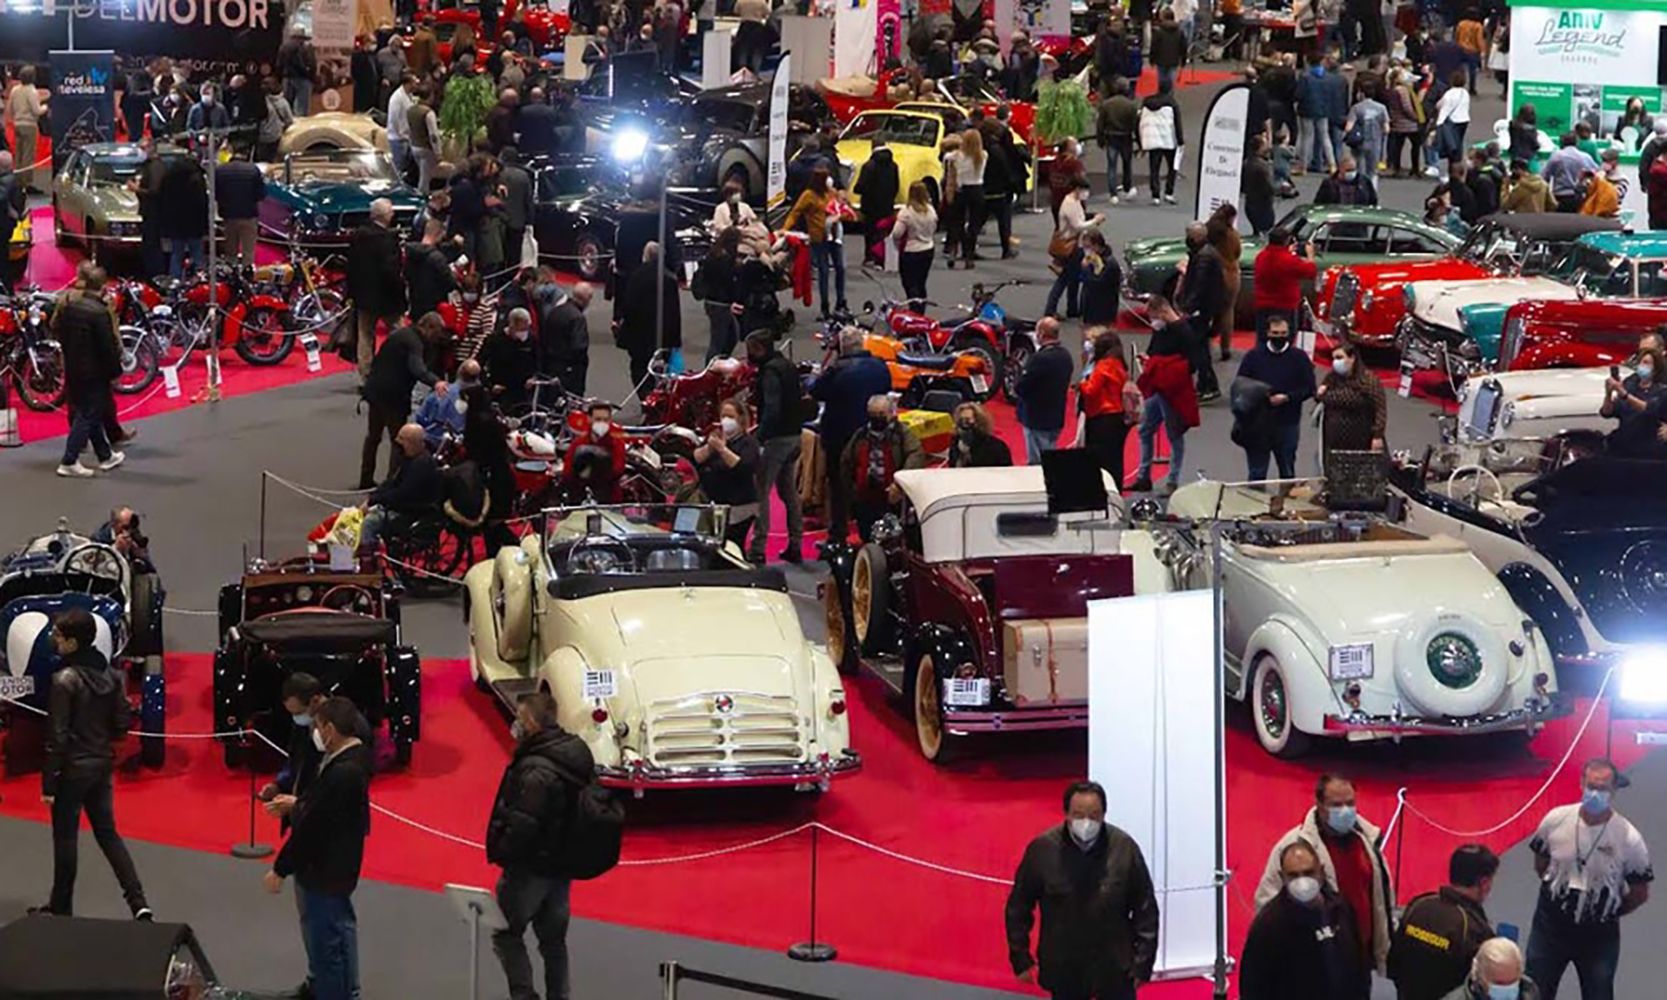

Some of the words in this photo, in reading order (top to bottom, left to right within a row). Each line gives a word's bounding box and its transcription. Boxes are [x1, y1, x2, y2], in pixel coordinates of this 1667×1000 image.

[1534, 18, 1627, 53] Legend
[59, 85, 106, 95] tevelesa
[0, 683, 33, 696] OTOR
